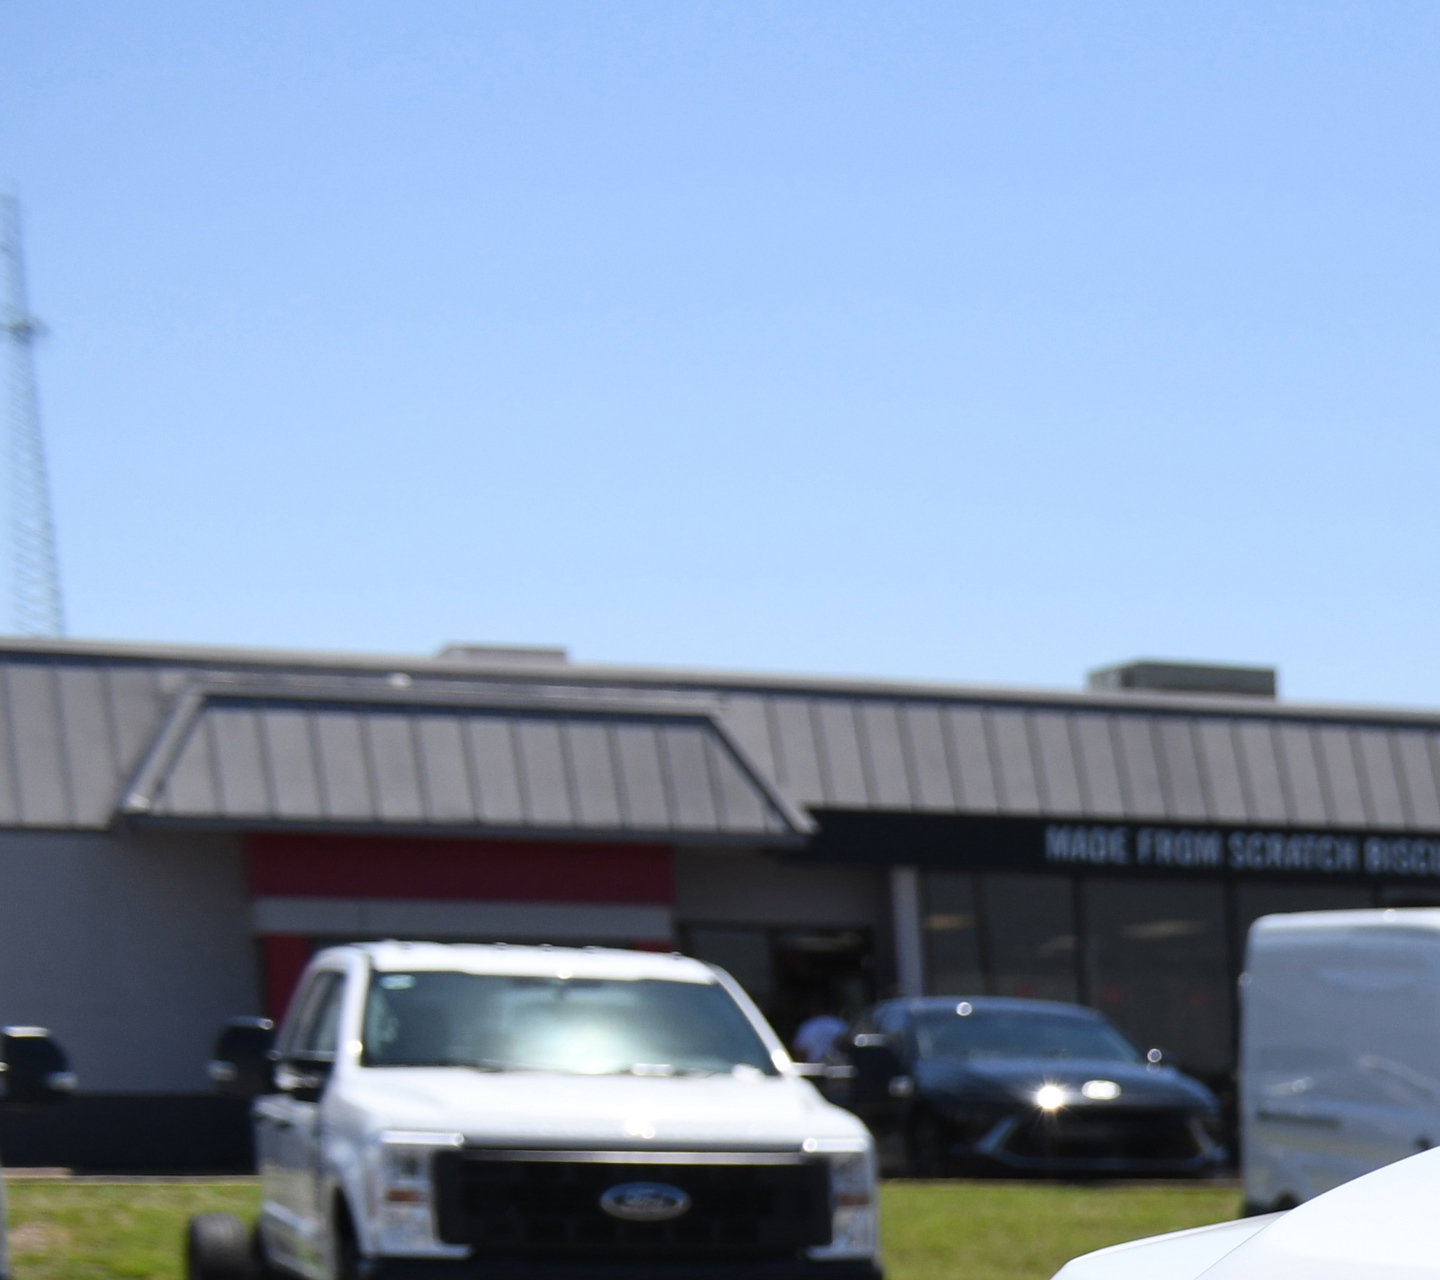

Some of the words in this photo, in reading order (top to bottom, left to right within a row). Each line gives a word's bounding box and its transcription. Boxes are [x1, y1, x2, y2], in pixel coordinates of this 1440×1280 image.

[1046, 823, 1129, 865] MADE
[1137, 828, 1222, 867] FROM
[1228, 831, 1356, 872] SCRATCH
